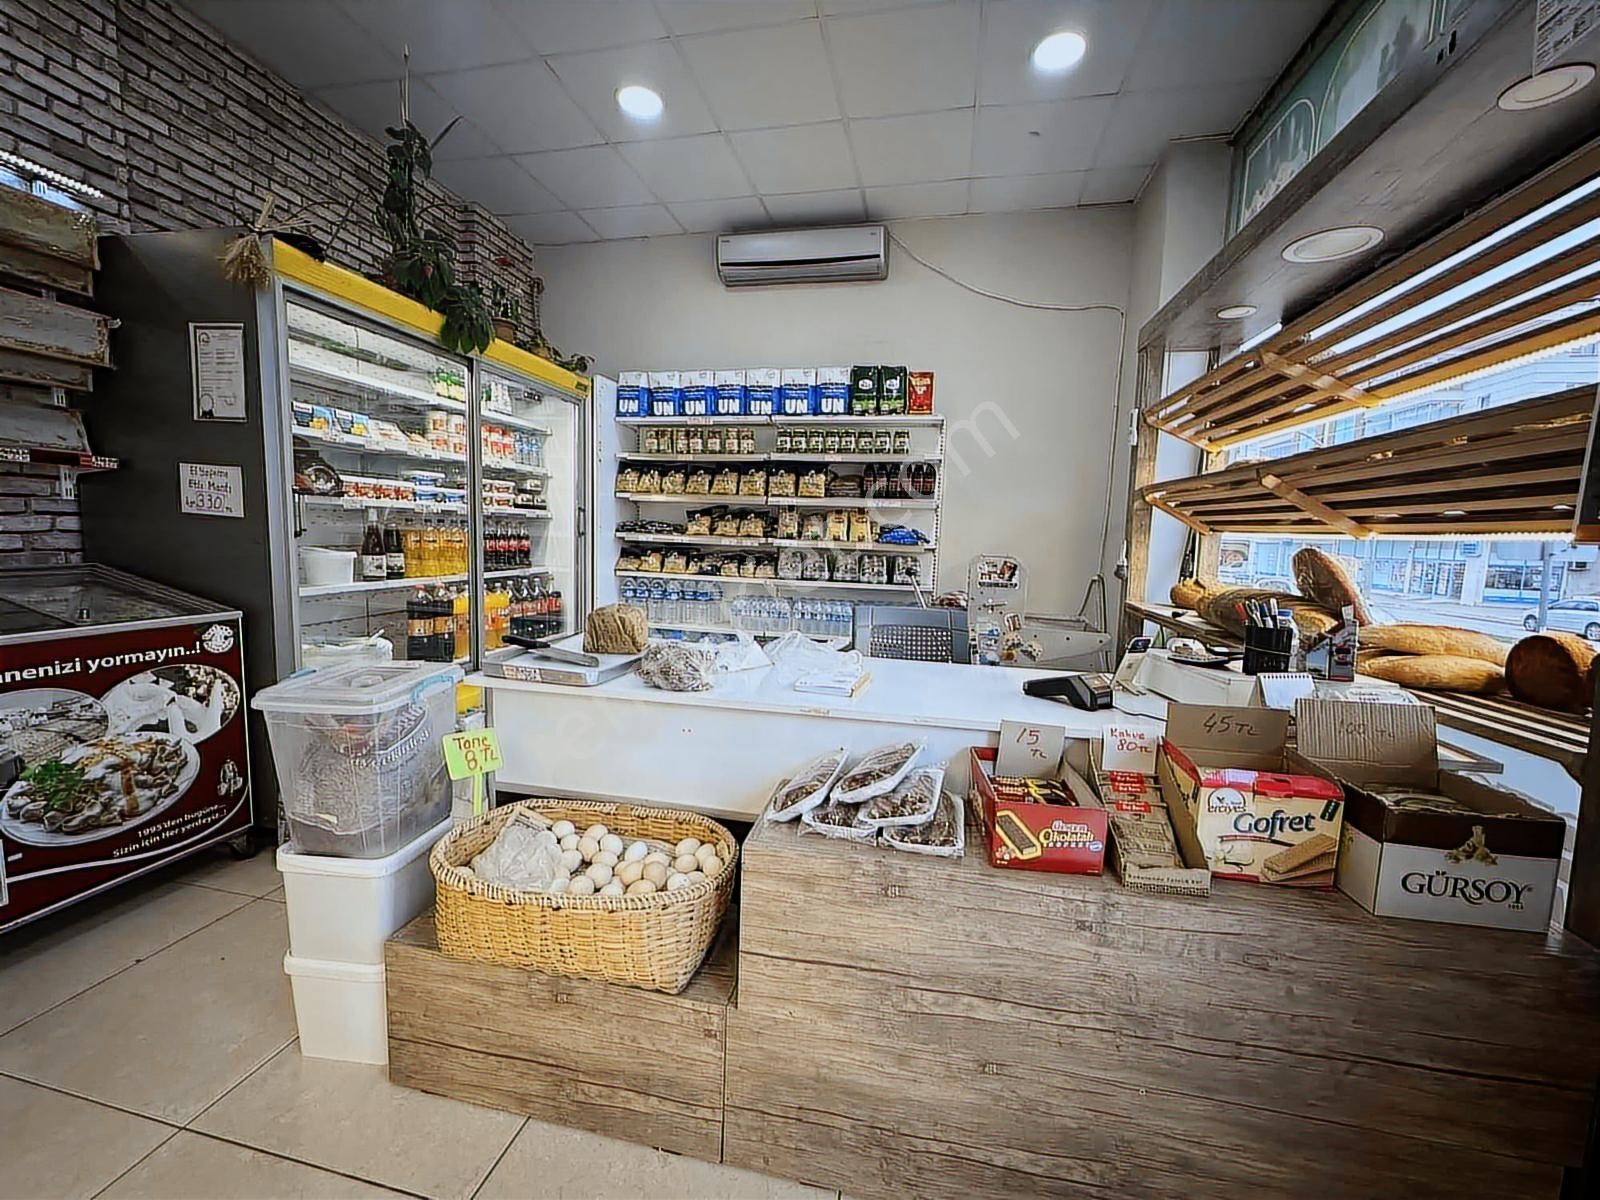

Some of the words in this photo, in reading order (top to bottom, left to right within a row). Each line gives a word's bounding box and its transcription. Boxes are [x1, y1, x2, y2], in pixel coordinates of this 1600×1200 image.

[619, 400, 639, 413] UN
[653, 401, 674, 415] UN
[685, 400, 706, 414] UN
[718, 399, 740, 413] UN
[751, 401, 772, 414] UN
[785, 399, 808, 413] UN
[821, 398, 844, 413] UN
[196, 493, 223, 510] 330
[87, 641, 201, 674] yormayın..!
[1016, 728, 1041, 745] 15
[1110, 728, 1145, 740] Kahve
[452, 736, 491, 751] Tane
[1233, 809, 1316, 839] Gofret
[1400, 869, 1531, 906] GÜRSOY
